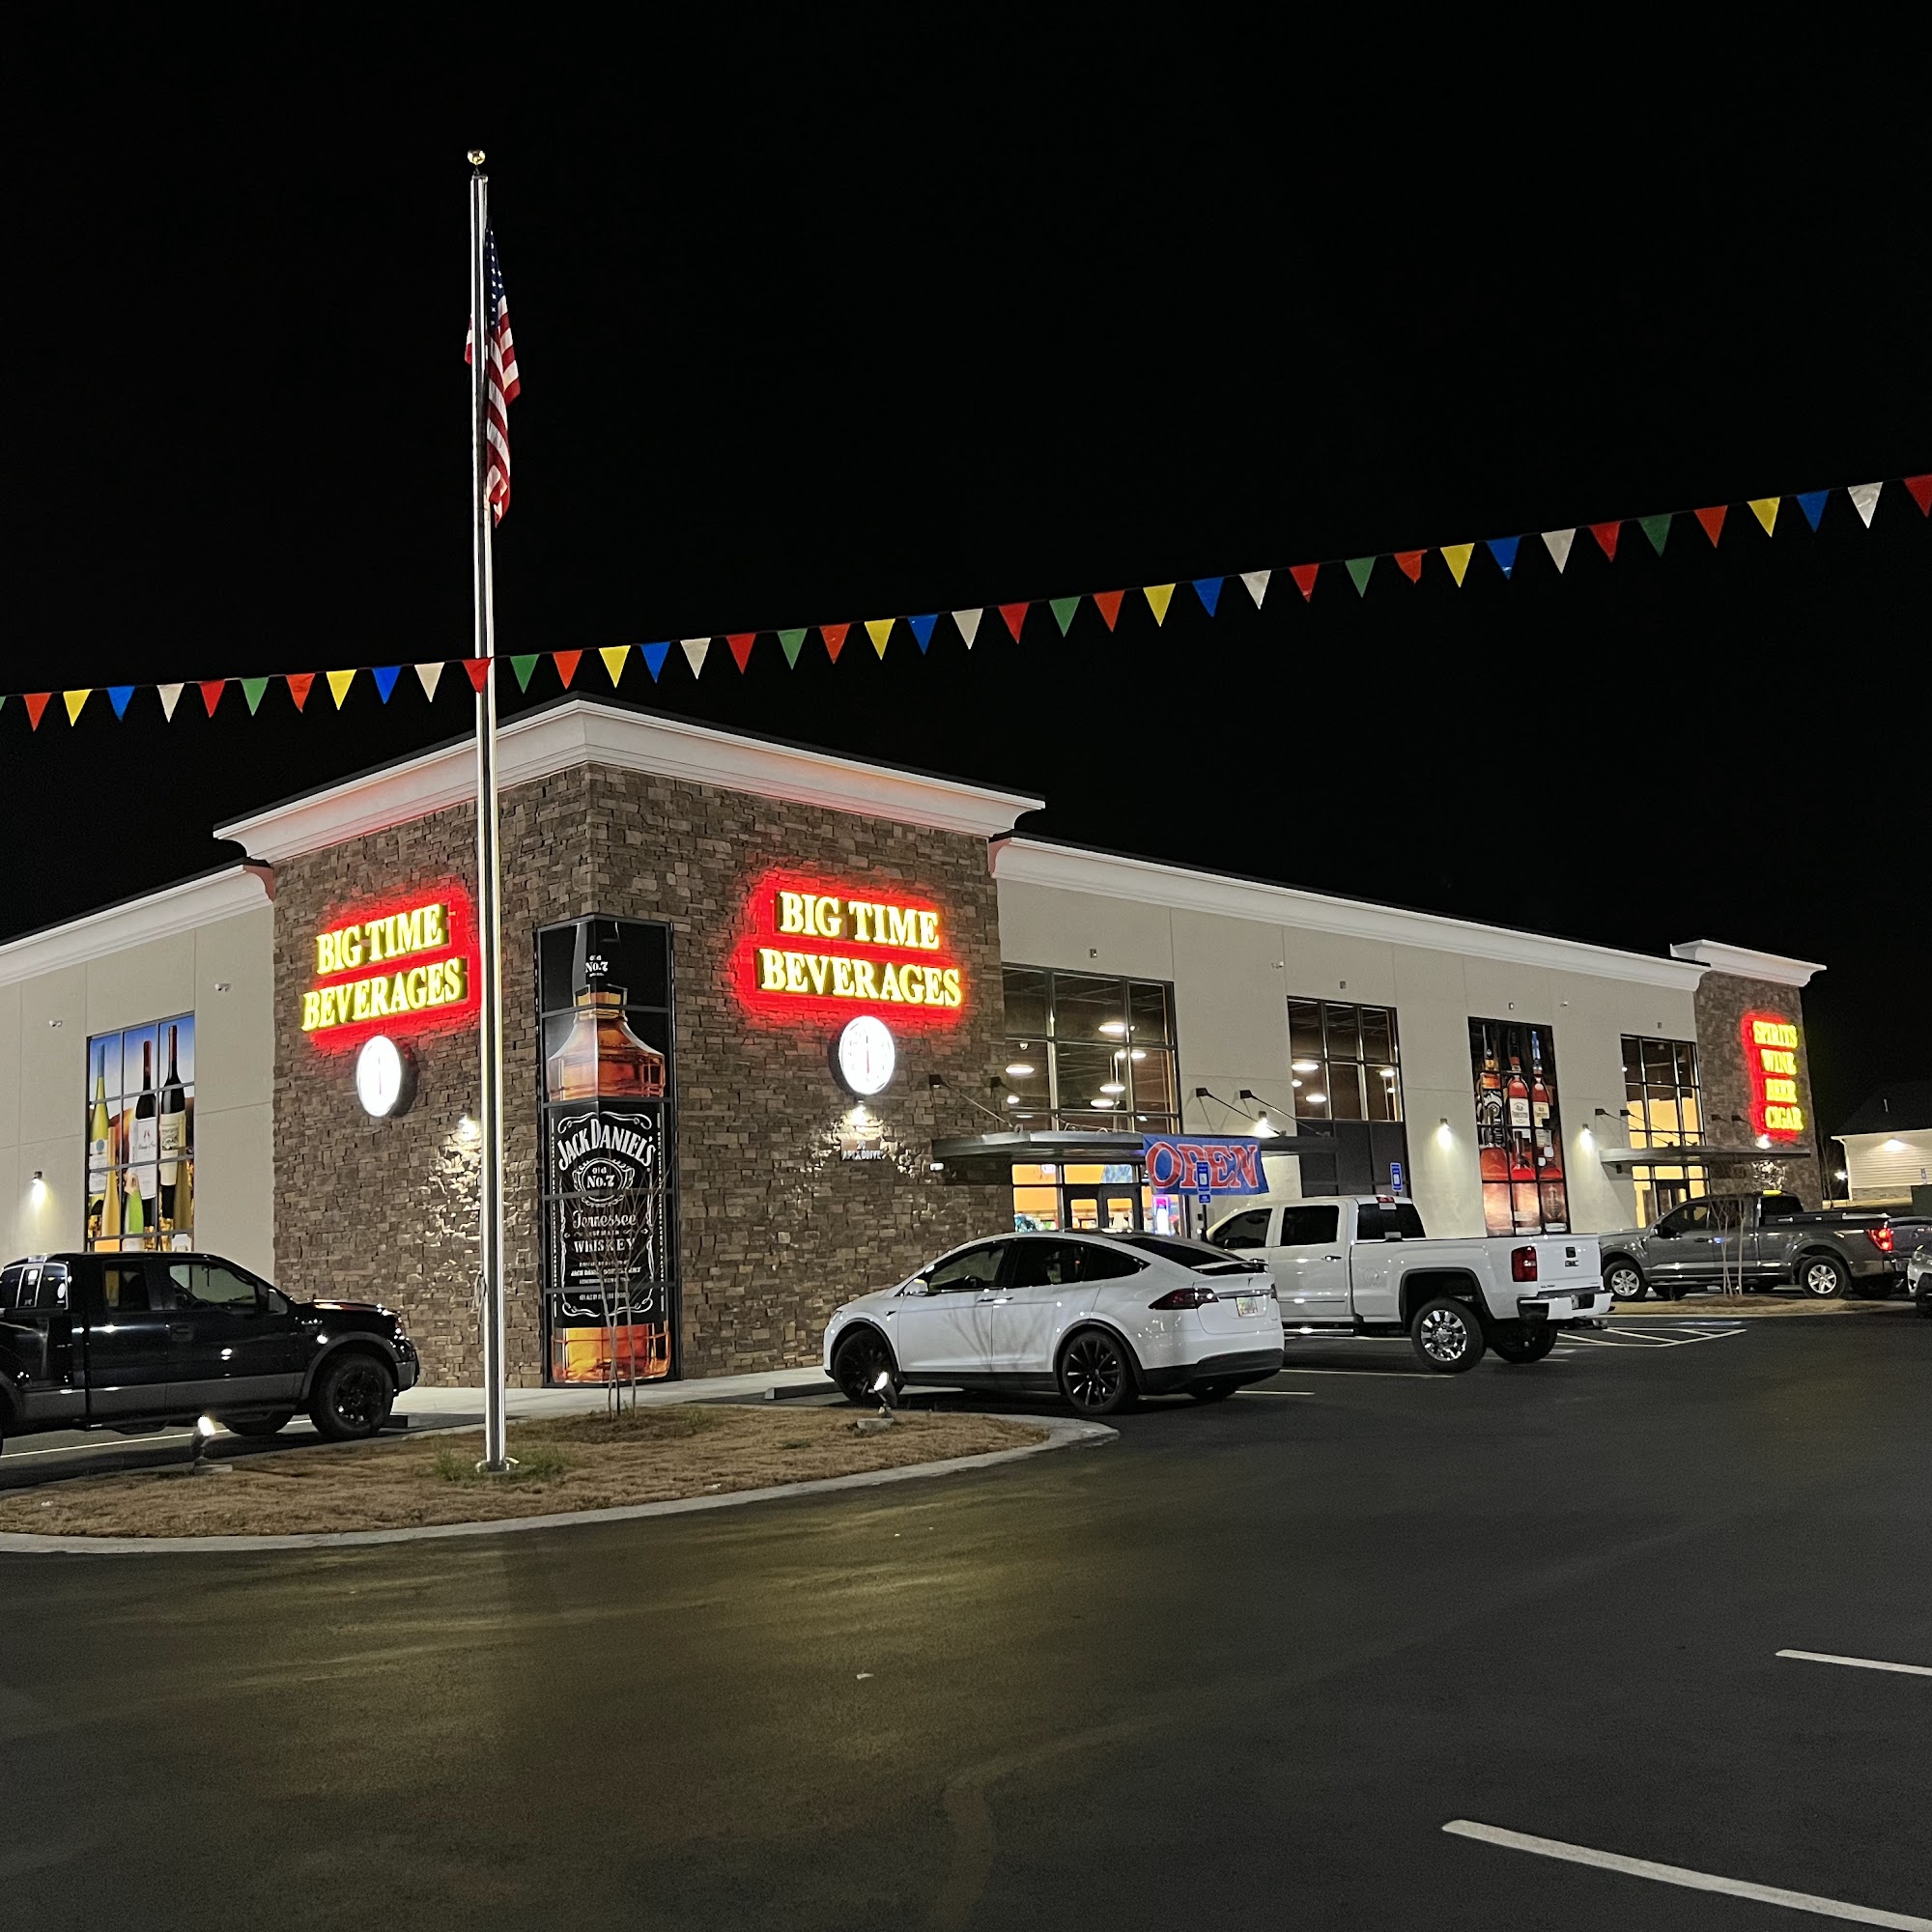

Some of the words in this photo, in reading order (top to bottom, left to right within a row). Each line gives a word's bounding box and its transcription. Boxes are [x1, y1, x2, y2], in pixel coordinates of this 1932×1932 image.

[780, 892, 842, 938] BIG
[848, 900, 940, 951] TIME
[316, 923, 362, 976] BIG
[365, 904, 443, 963] TIME
[584, 961, 609, 973] No.7
[758, 948, 963, 1008] BEVERAGES
[301, 957, 463, 1032] BEVERAGES
[1752, 1020, 1799, 1048] SPIRITS
[1760, 1048, 1797, 1075] WINE
[1765, 1078, 1797, 1103] BEER
[1765, 1105, 1804, 1131] CIGAR
[557, 1128, 591, 1172] JACK
[590, 1118, 656, 1168] DANIEL'S
[1146, 1141, 1259, 1189] OPEN
[586, 1175, 615, 1189] No.7
[572, 1209, 637, 1229] Tennessee
[574, 1237, 636, 1254] WHISKEY
